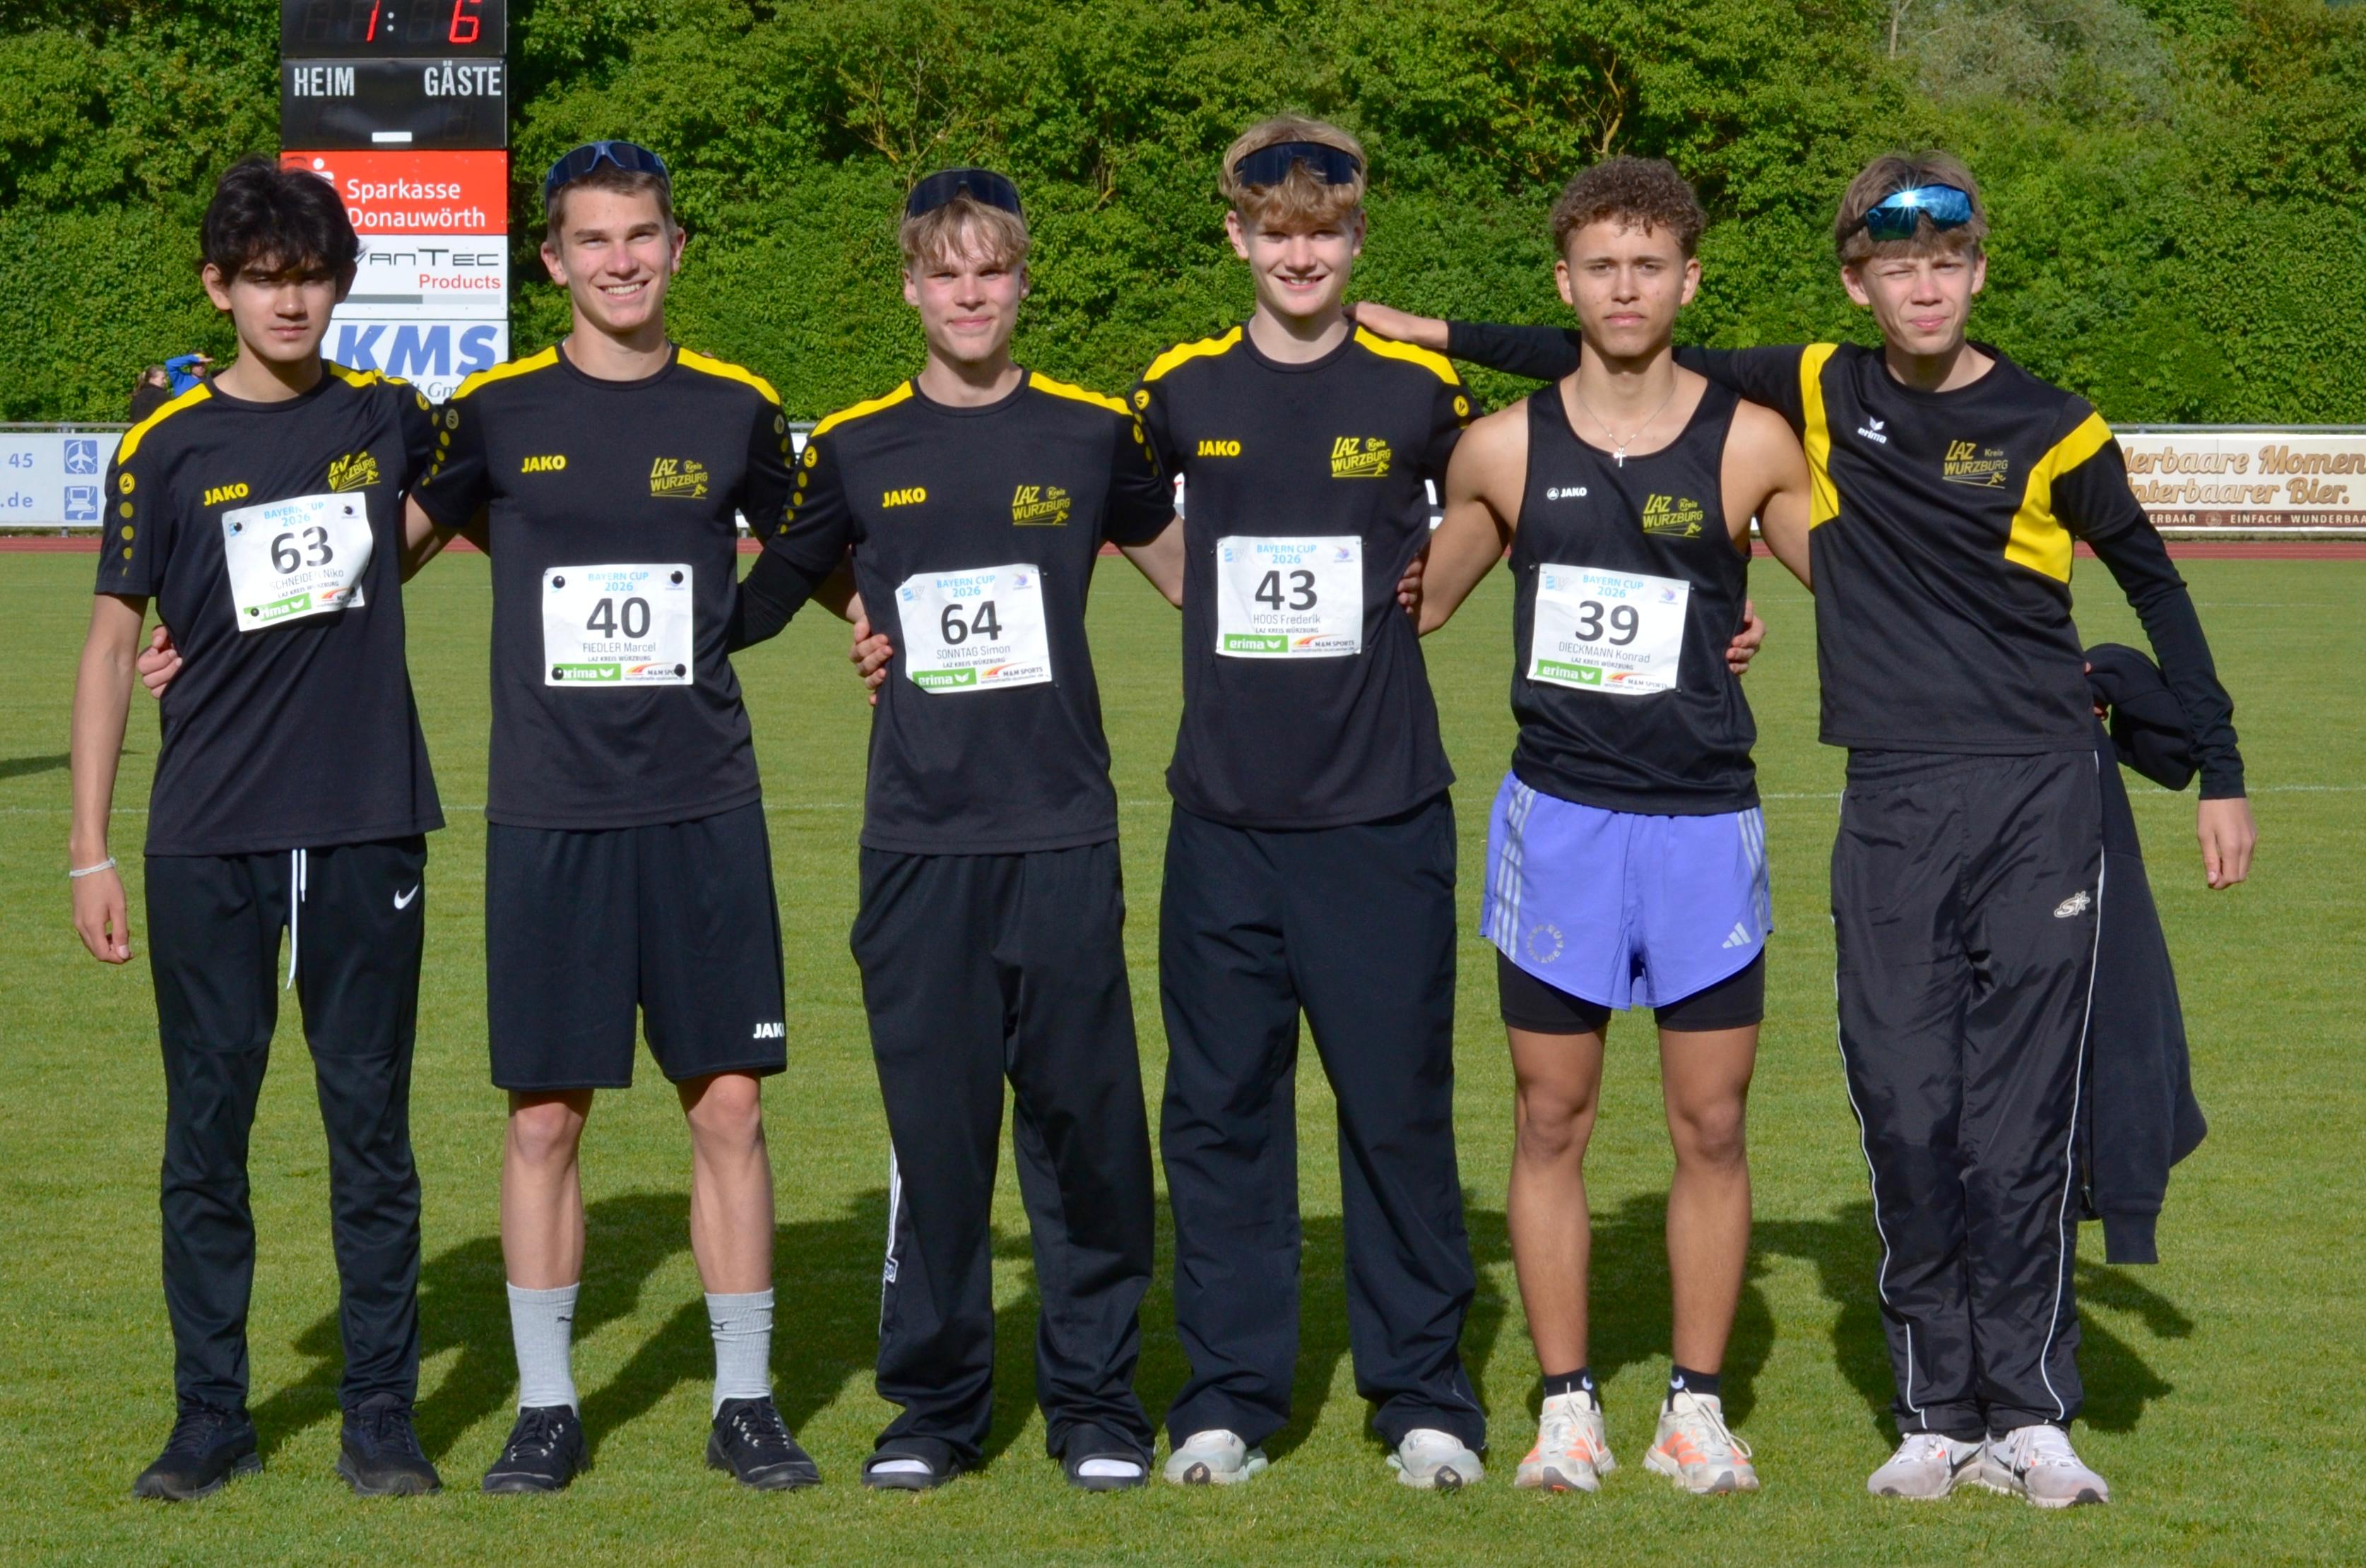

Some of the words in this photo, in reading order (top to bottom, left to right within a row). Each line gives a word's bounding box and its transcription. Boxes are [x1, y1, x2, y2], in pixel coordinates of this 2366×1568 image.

[294, 67, 355, 97] HEIM
[424, 61, 502, 97] GÄSTE
[347, 178, 461, 203] Sparkasse
[348, 207, 486, 228] Donauwörth
[419, 273, 502, 289] Products
[336, 325, 498, 376] KMS
[1857, 427, 1887, 444] erima
[1197, 441, 1241, 456] JAKO
[1332, 436, 1360, 459] LAZ
[1945, 440, 1976, 461] LAZ
[8, 453, 34, 468] 45
[521, 456, 566, 473] JAKO
[651, 458, 678, 478] LAZ
[2258, 445, 2366, 475] Momen
[204, 483, 249, 506] JAKO
[882, 487, 926, 508] JAKO
[1012, 485, 1040, 506] LAZ
[1561, 487, 1587, 497] JAKO
[2128, 477, 2281, 504] nterbaarer
[2286, 477, 2350, 504] Bier.
[1643, 494, 1672, 514] LAZ
[264, 506, 303, 520] BAYERN
[282, 514, 311, 527] 2026
[2230, 514, 2282, 523] EINFACH
[271, 526, 333, 574] 63
[1256, 544, 1295, 554] BAYERN
[1296, 544, 1317, 554] CUP
[1272, 554, 1301, 564] 2026
[323, 568, 344, 579] Niko
[588, 573, 627, 581] BAYERN
[629, 572, 649, 581] CUP
[937, 576, 974, 589] BAYERN
[976, 574, 995, 586] CUP
[604, 582, 634, 591] 2026
[1255, 569, 1318, 611] 43
[1583, 575, 1622, 588] BAYERN
[1624, 578, 1644, 590] CUP
[953, 586, 981, 598] 2026
[1597, 586, 1626, 598] 2026
[259, 604, 290, 620] rima
[586, 597, 651, 639] 40
[1253, 614, 1279, 625] HOOS
[1281, 613, 1321, 625] Frederik
[940, 600, 1002, 646] 64
[1575, 600, 1640, 646] 39
[583, 642, 622, 653] FIEDLER
[624, 641, 656, 653] Marcel
[937, 646, 978, 660] SONNTAG
[981, 643, 1011, 656] Simon
[1229, 639, 1265, 651] erima
[1558, 641, 1614, 660] DIECKMANN
[1616, 650, 1651, 664] Konrad
[954, 660, 971, 668] KREIS
[1583, 658, 1599, 667] KREIS
[563, 667, 598, 679] rima
[918, 674, 954, 687] erima
[1020, 666, 1043, 675] SPORTS
[1542, 665, 1580, 680] erima
